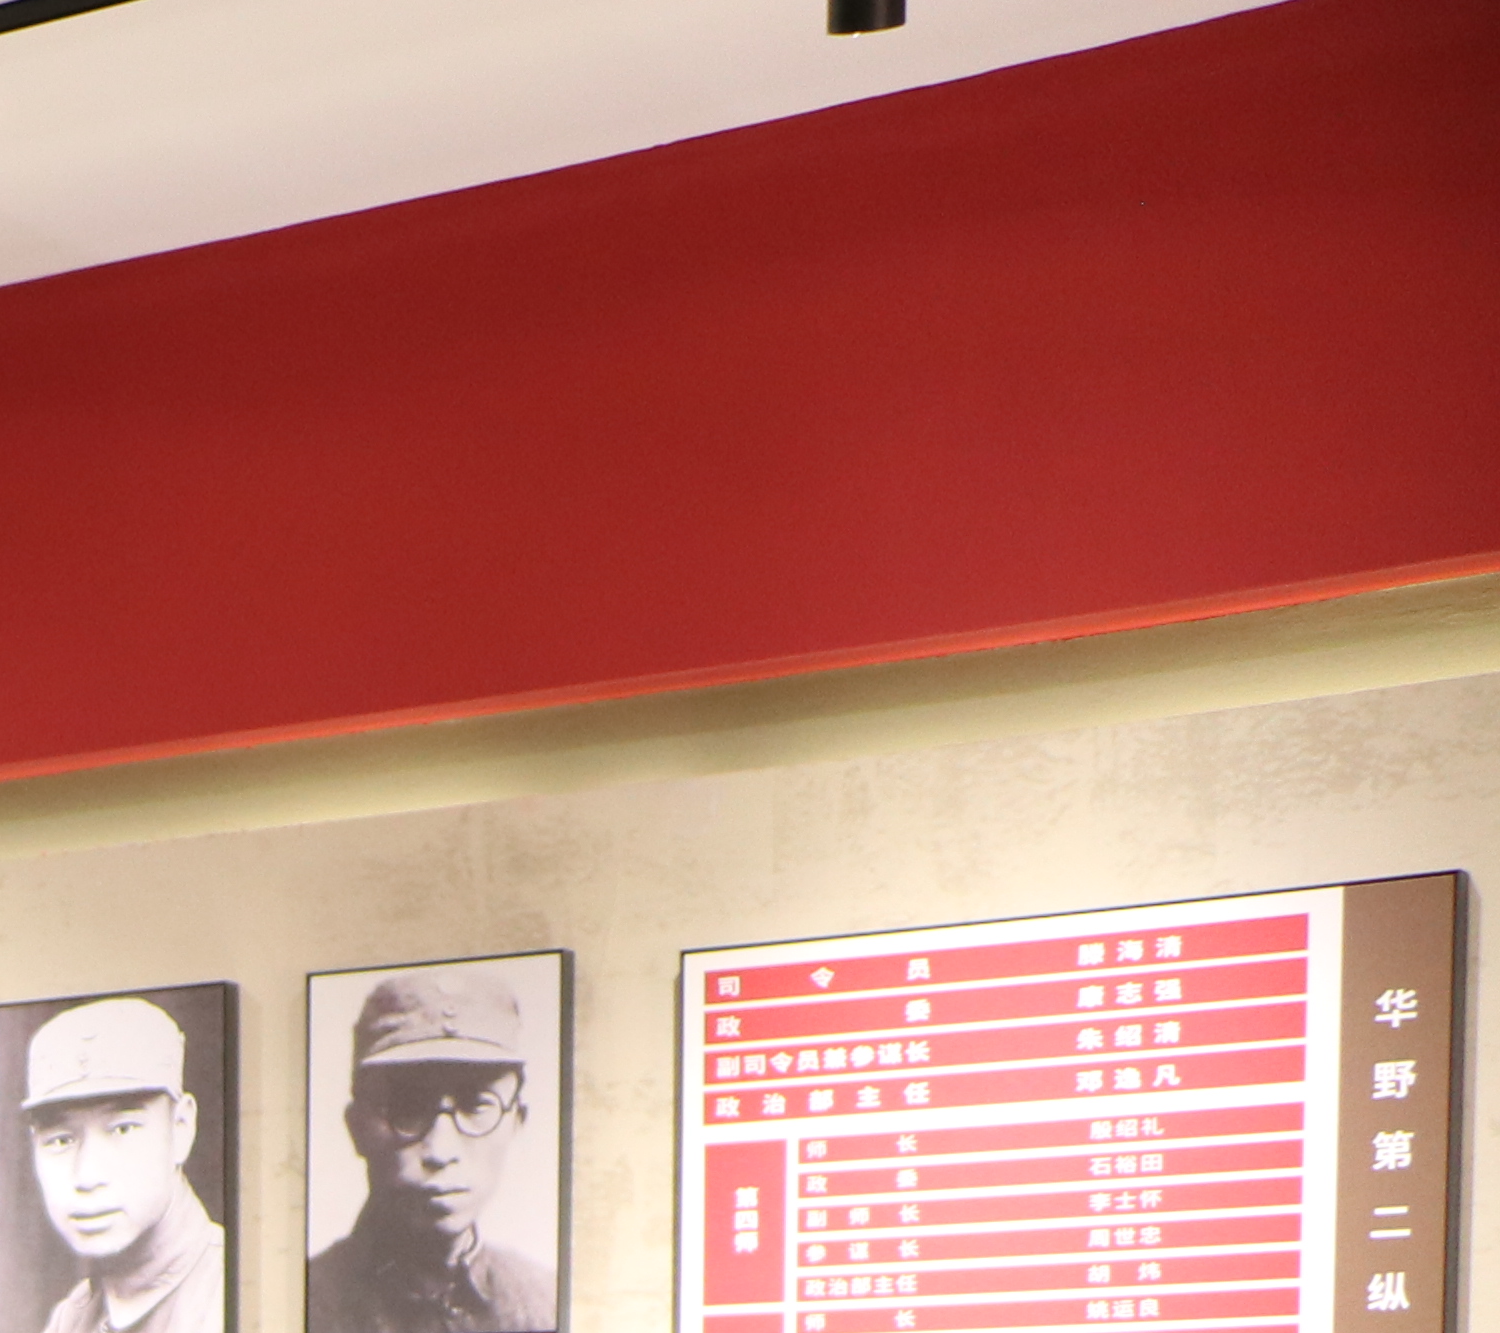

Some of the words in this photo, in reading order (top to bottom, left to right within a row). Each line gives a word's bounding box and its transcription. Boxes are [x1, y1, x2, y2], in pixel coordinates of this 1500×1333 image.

[717, 957, 931, 997] 司令员
[716, 999, 931, 1038] 政委
[716, 1040, 931, 1079] 副司令员兼参谋长
[716, 1082, 931, 1117] 政治部主任
[806, 1133, 918, 1159] 师长
[806, 1168, 918, 1194] 政委
[734, 1185, 759, 1255] 第四师
[806, 1205, 920, 1229] 副师长
[806, 1239, 920, 1263] 参谋长
[805, 1274, 918, 1297] 政治部主任
[805, 1310, 916, 1333] 师长
